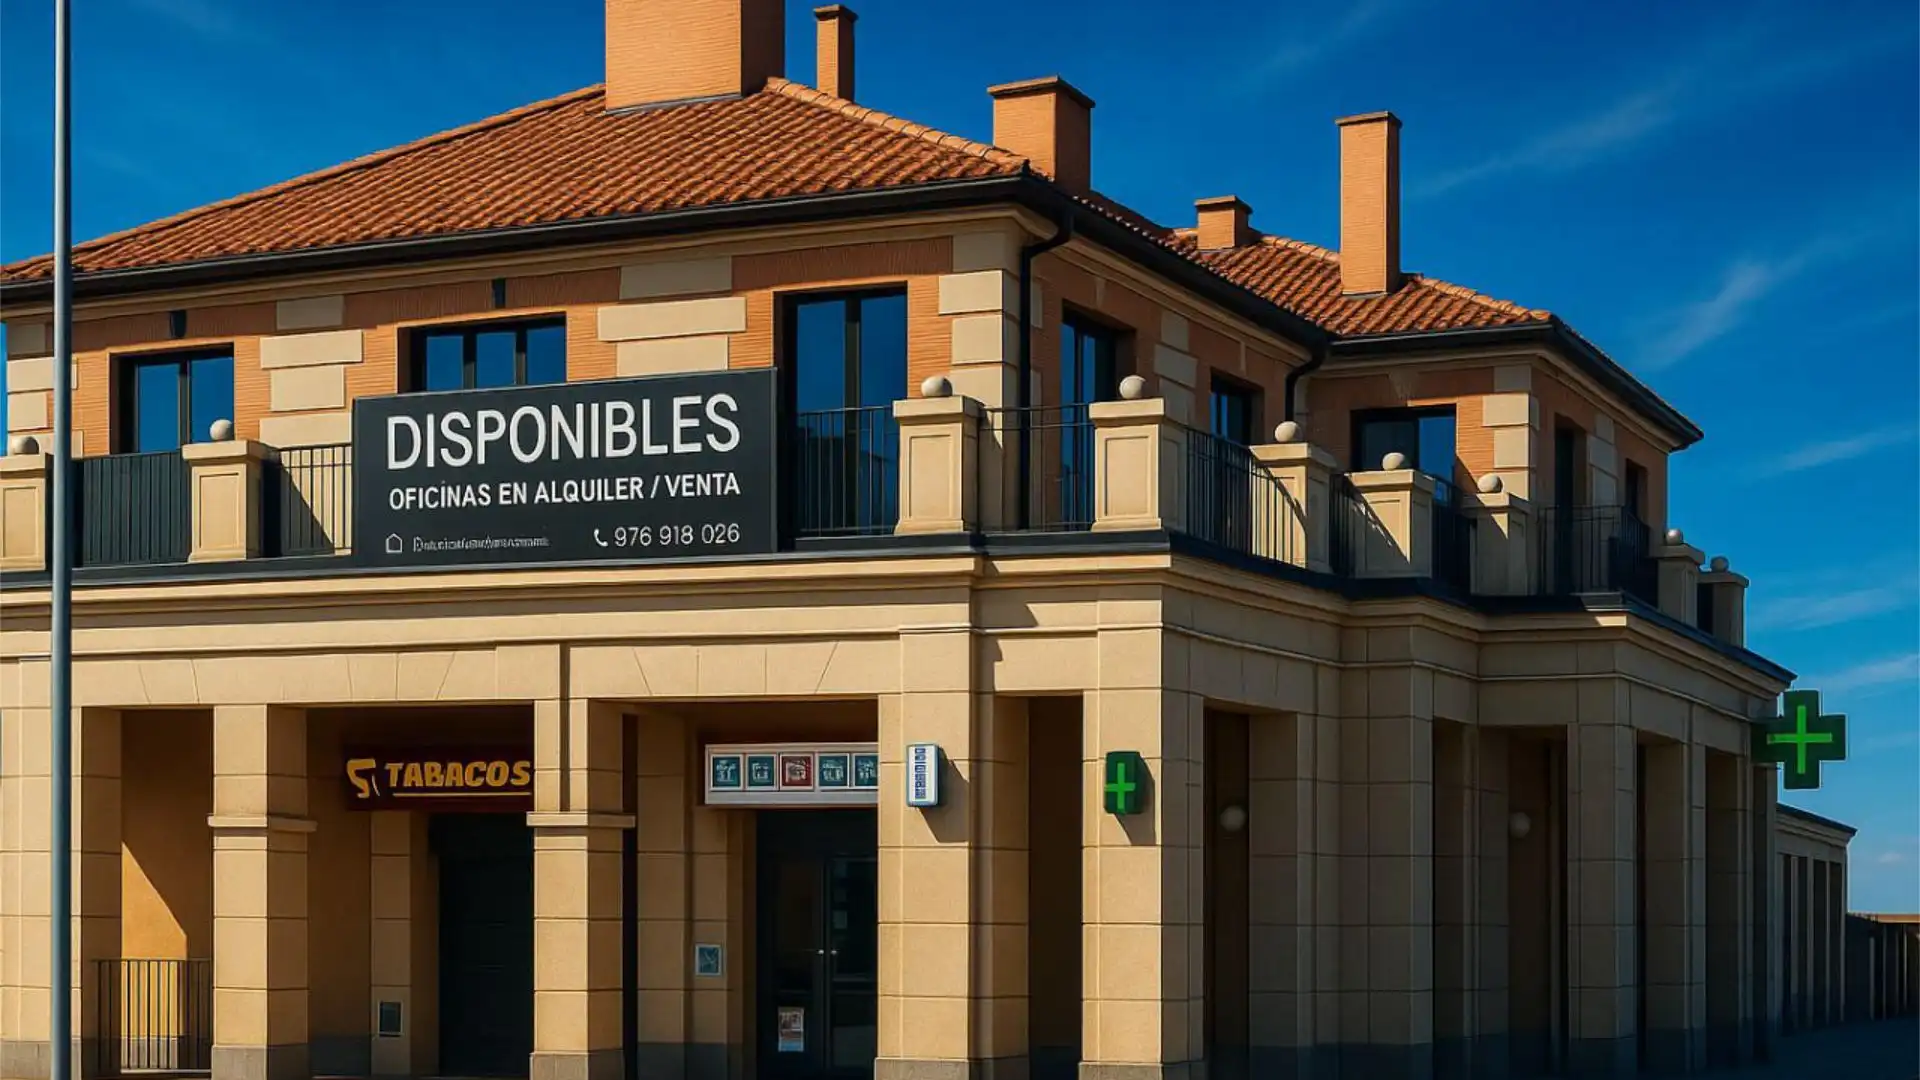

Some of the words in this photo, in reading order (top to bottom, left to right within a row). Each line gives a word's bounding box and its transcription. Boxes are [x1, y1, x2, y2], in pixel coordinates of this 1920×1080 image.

[387, 393, 741, 470] DISPONIBLES
[499, 482, 527, 505] EN
[533, 476, 645, 504] ALQUILER
[650, 475, 661, 499] /
[665, 472, 741, 498] VENTA
[614, 525, 652, 547] 976
[659, 523, 694, 546] 918
[701, 522, 741, 544] 026
[385, 760, 531, 787] TABACOS
